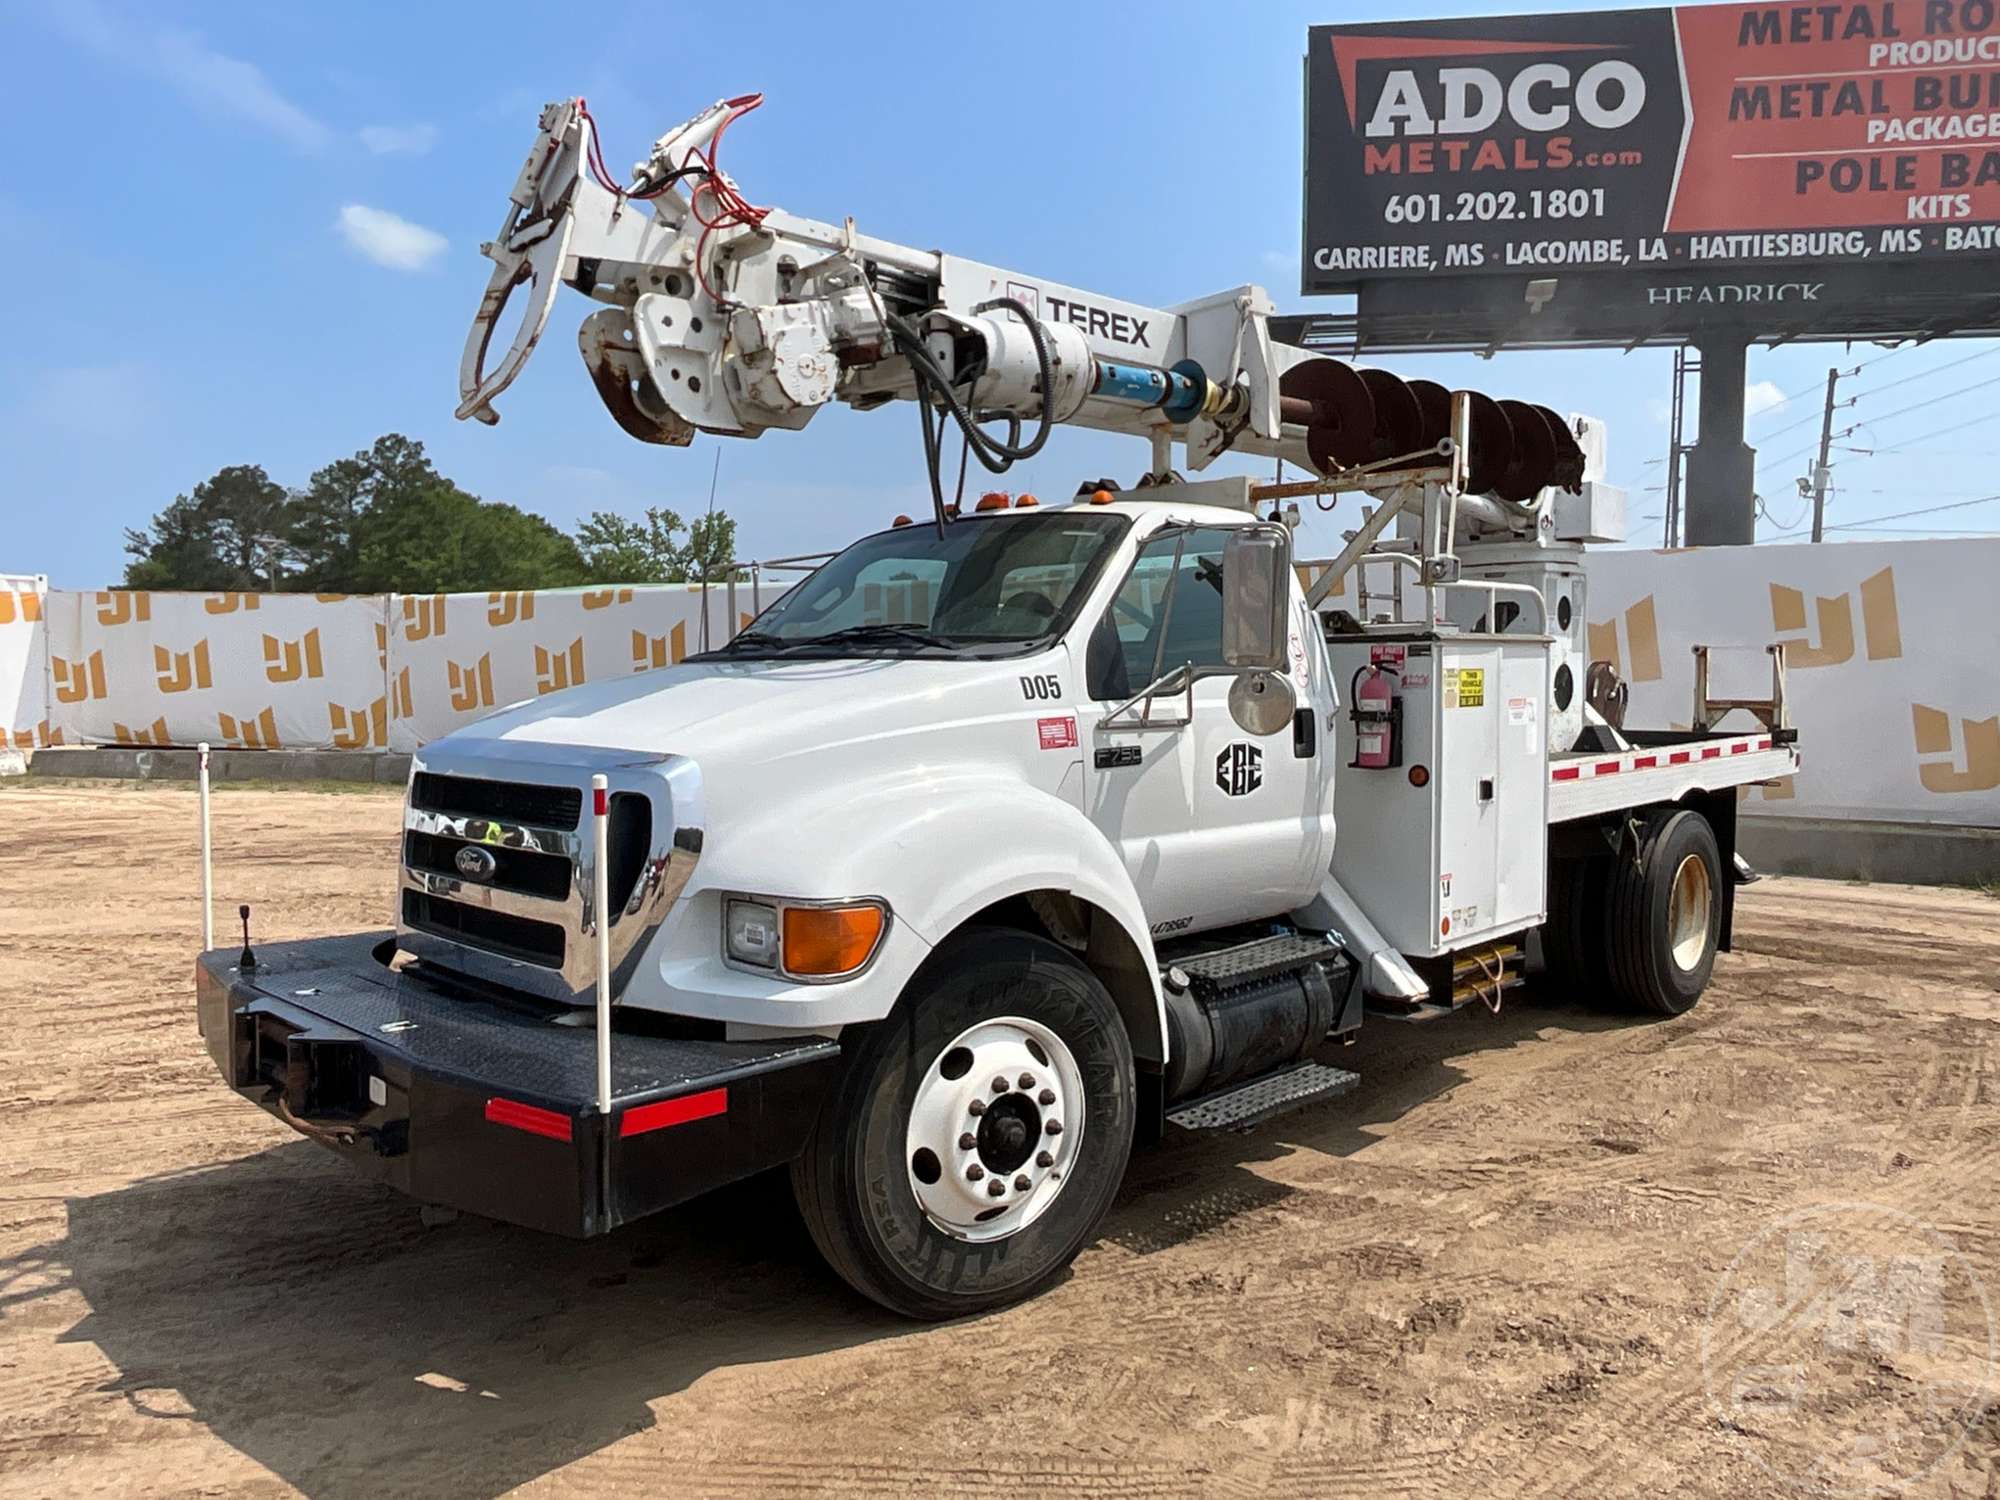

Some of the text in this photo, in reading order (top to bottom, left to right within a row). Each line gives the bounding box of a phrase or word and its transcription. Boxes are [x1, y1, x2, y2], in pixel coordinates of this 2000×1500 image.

[1737, 3, 1901, 46] METAL
[1365, 60, 1646, 137] ADCO
[1728, 79, 1890, 121] METAL
[1867, 113, 2000, 143] PACKAGE
[1795, 155, 1918, 194] POLE
[1384, 188, 1604, 223] 601.202.1801
[1907, 194, 1971, 219] KITS
[1314, 225, 2000, 271] CARRIERE, MS LACOMBE, LA HATTIESBURG, MS BAT
[1046, 296, 1151, 348] TEREX
